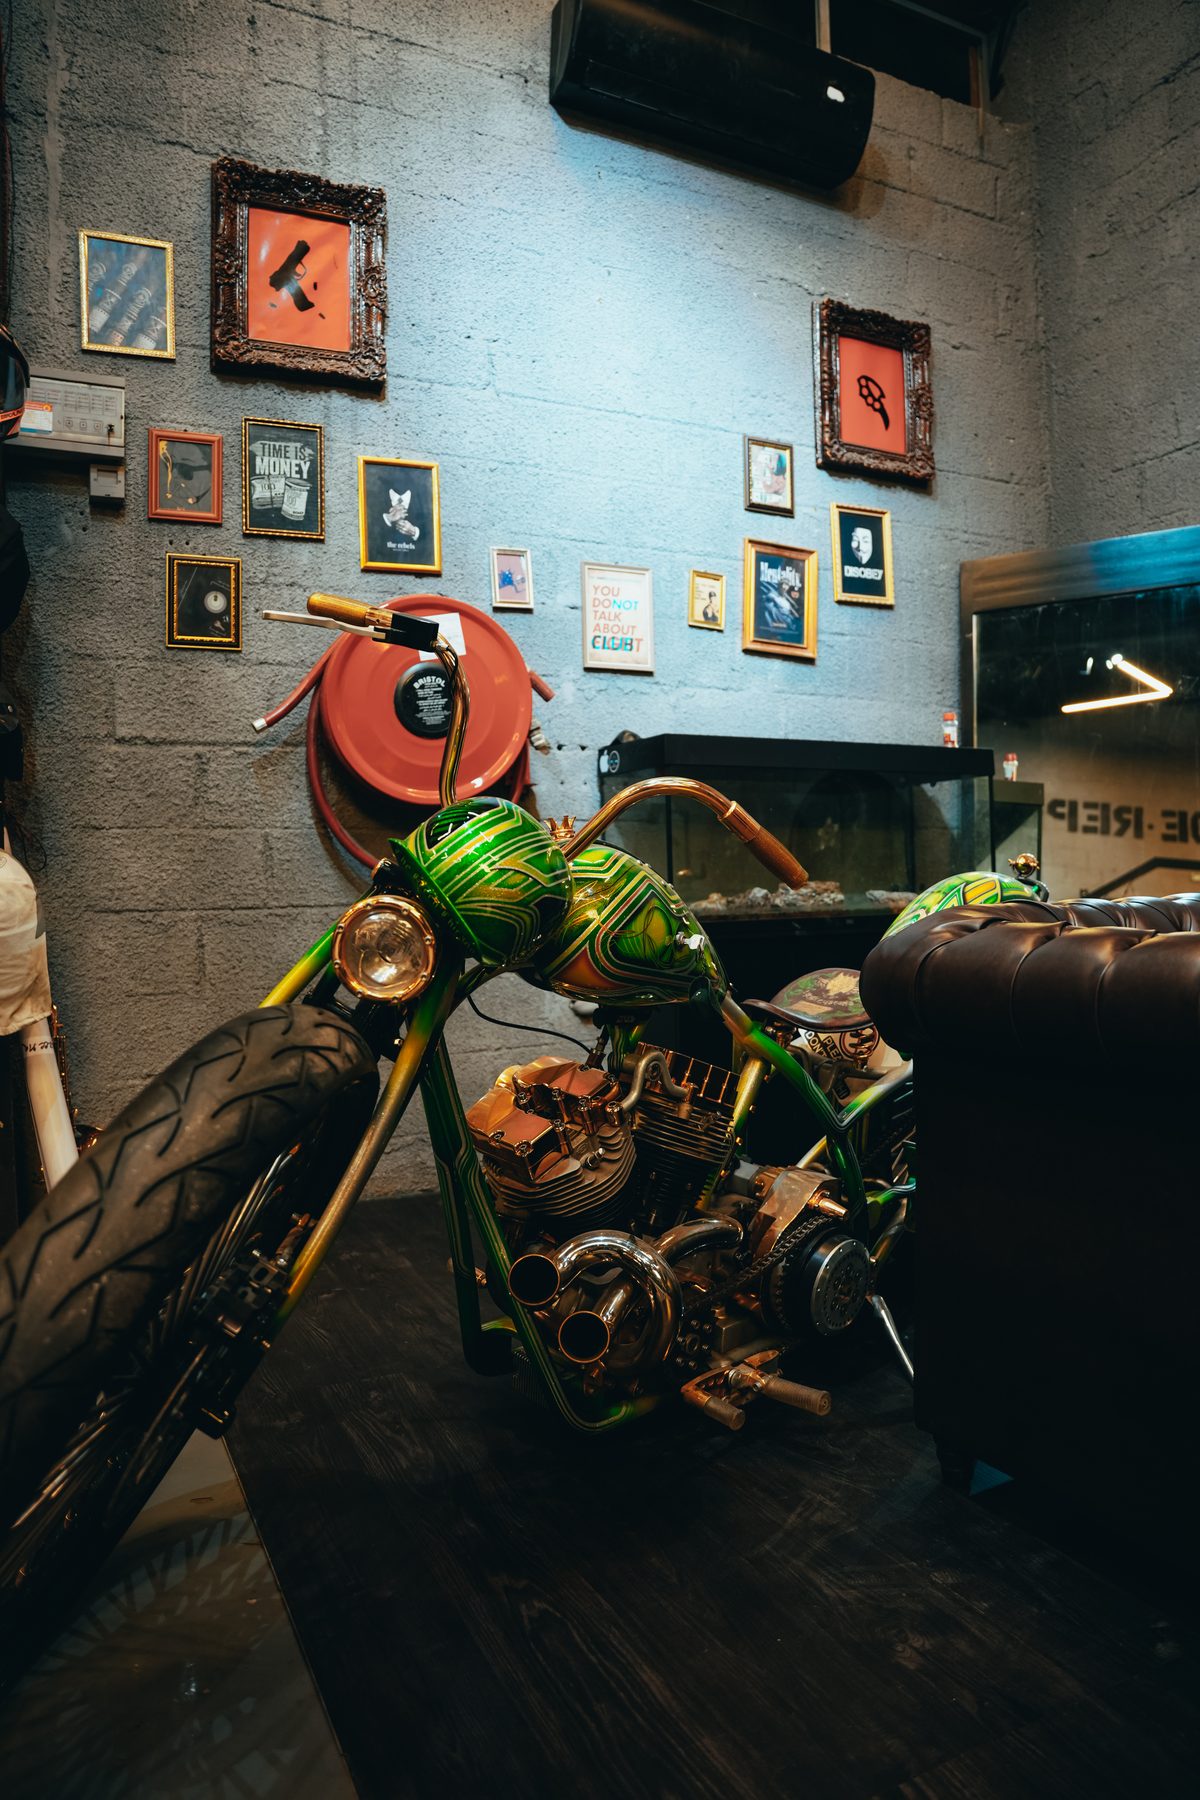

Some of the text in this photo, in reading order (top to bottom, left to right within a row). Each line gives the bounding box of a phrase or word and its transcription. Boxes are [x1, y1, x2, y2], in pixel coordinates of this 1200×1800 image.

[260, 443, 307, 461] TIME IS
[255, 457, 311, 479] MONEY
[397, 542, 416, 551] rebels
[844, 565, 883, 581] DISOBEY
[592, 585, 621, 597] YOU
[592, 610, 622, 622] TALK
[592, 623, 637, 636] ABOUT
[413, 676, 446, 689] BRISTOL
